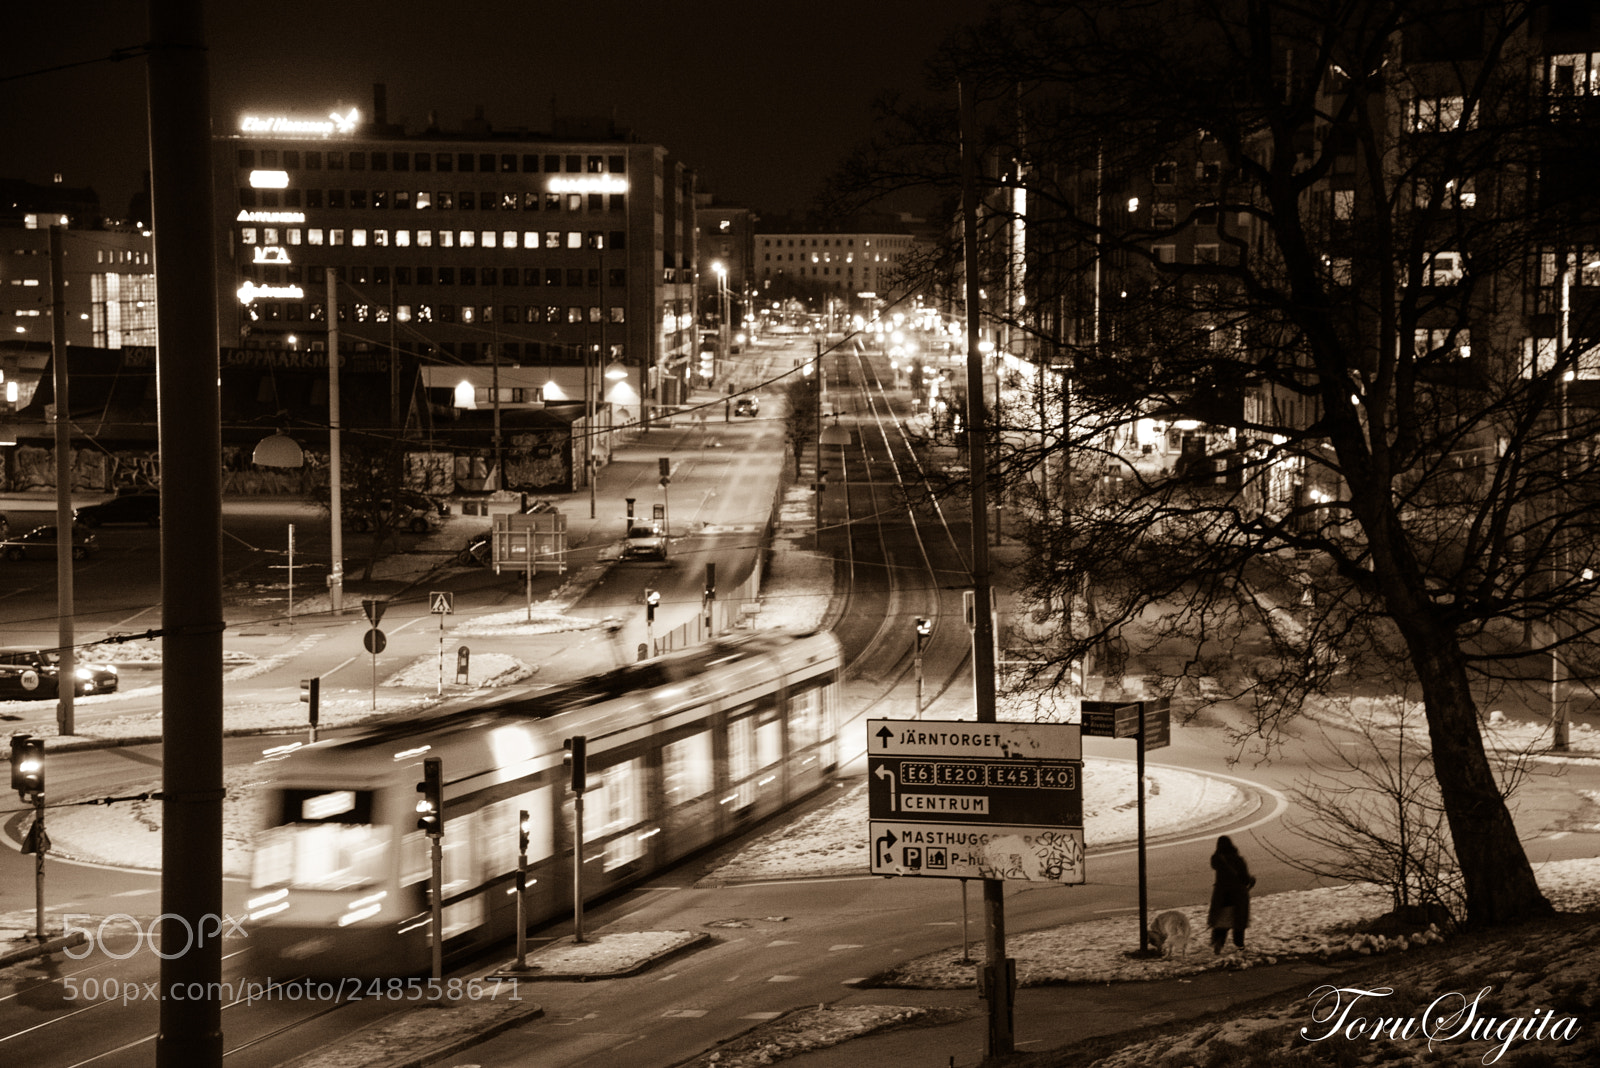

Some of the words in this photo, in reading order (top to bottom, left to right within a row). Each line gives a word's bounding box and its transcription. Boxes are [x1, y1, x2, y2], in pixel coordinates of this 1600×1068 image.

[900, 729, 1001, 747] JÄRNTORGET
[908, 767, 928, 780] E6
[945, 768, 977, 781] E20
[997, 769, 1029, 783] E45
[1045, 771, 1068, 784] 40
[905, 796, 984, 811] CENTRUM
